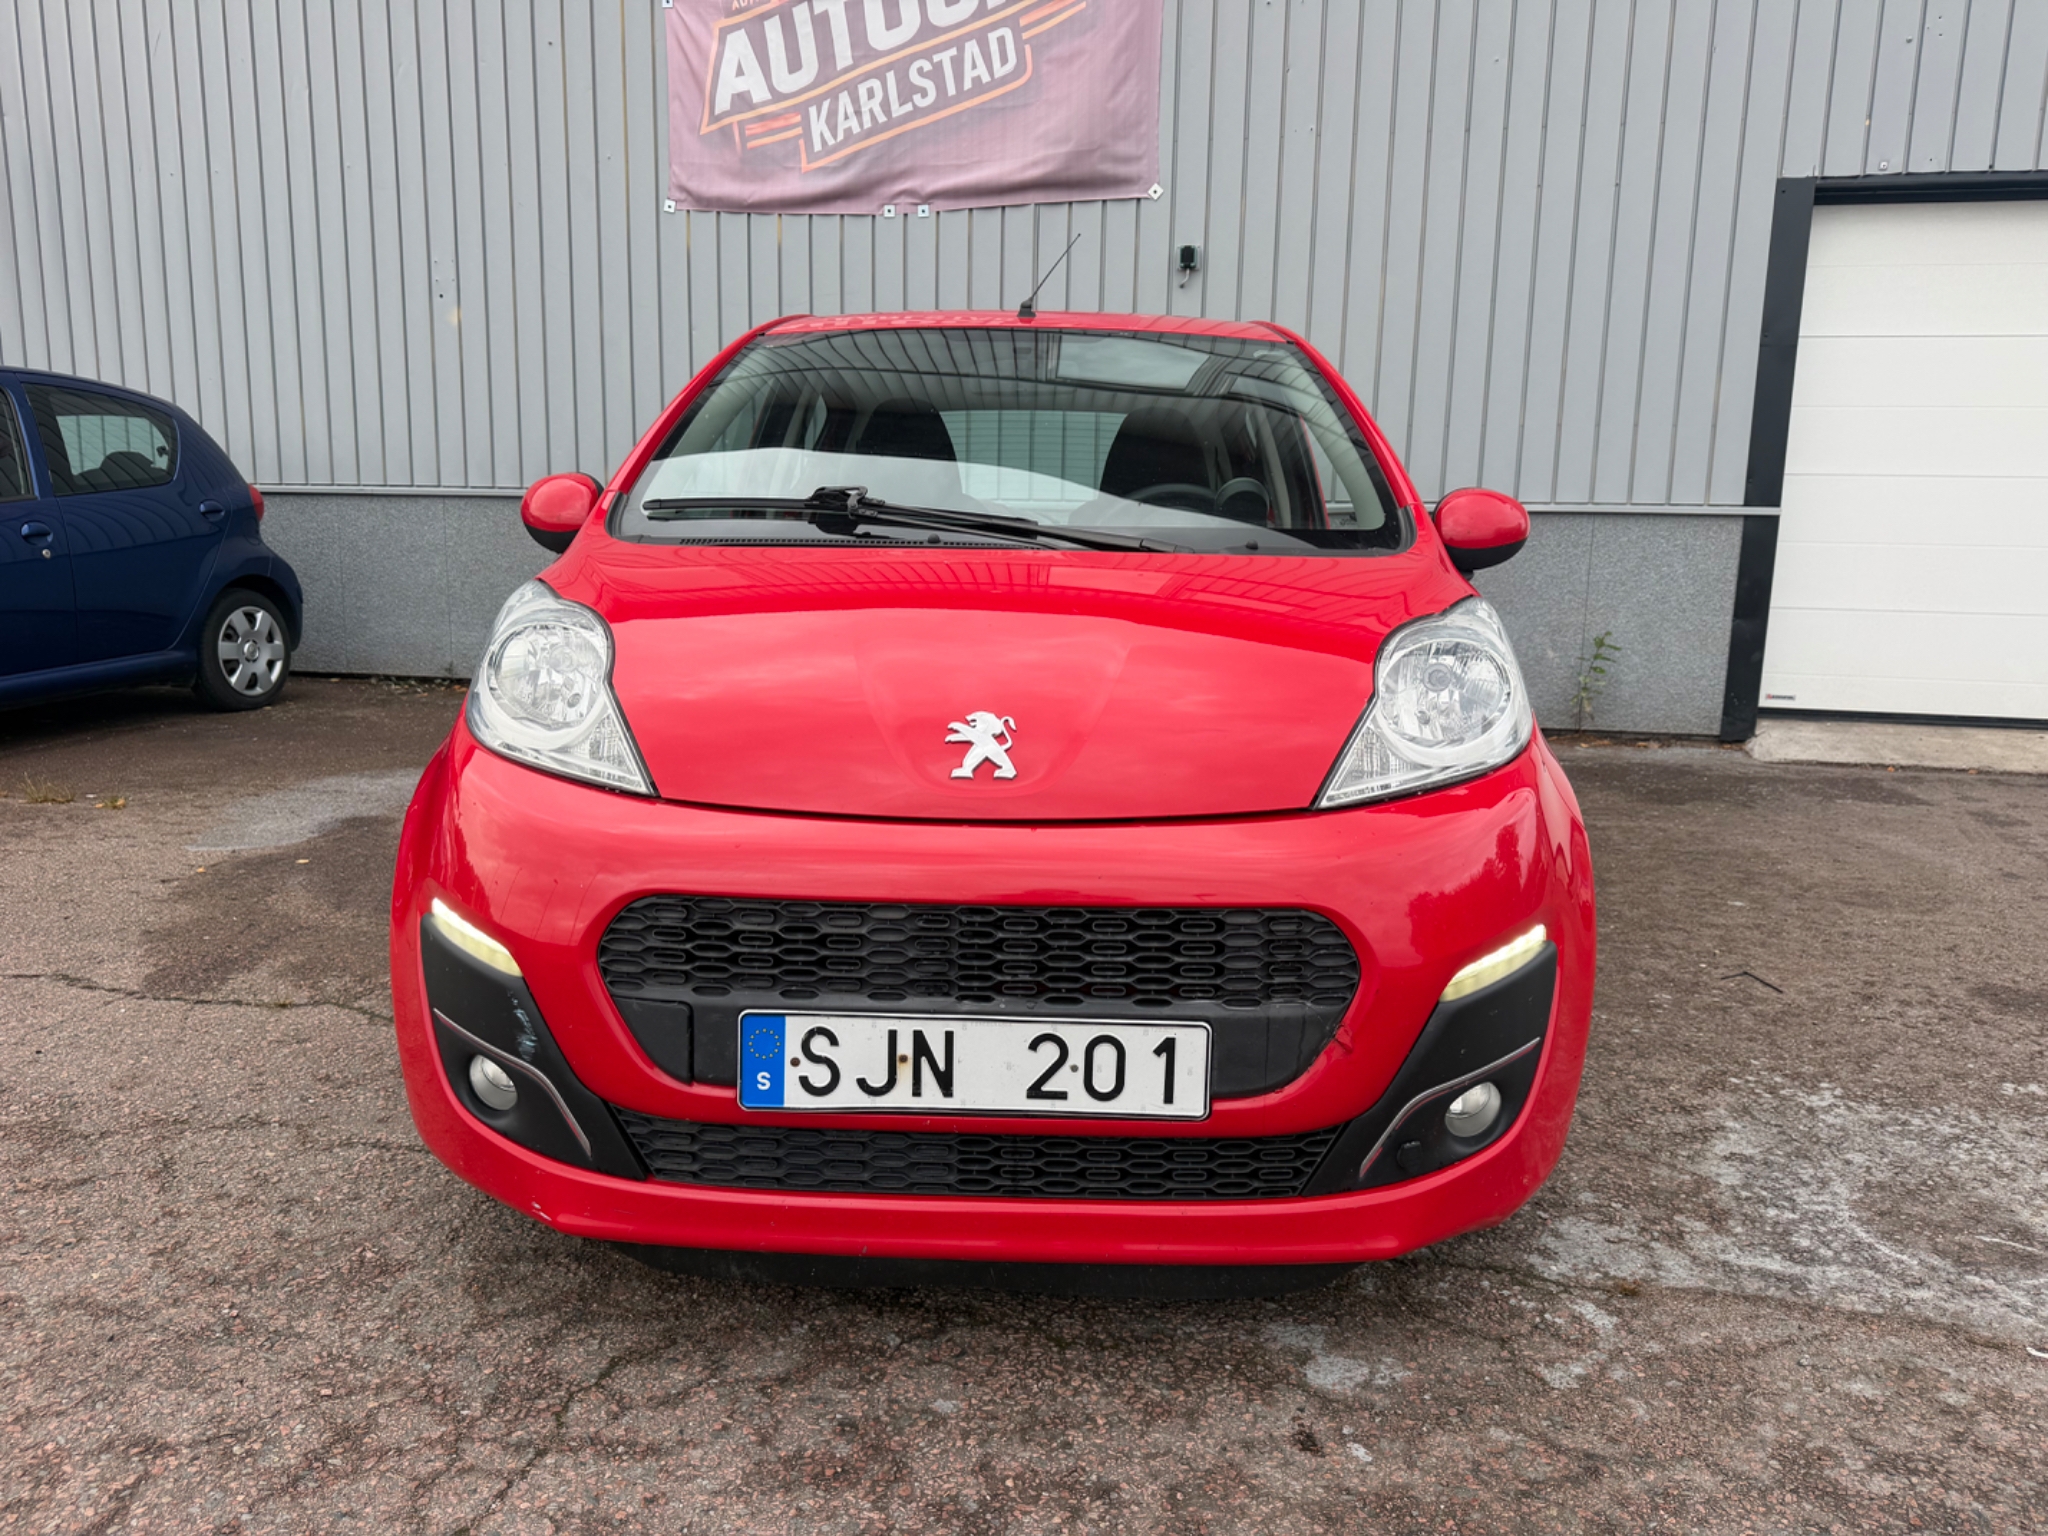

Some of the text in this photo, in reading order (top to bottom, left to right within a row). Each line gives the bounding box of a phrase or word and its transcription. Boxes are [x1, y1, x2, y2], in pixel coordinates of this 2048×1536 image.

[714, 0, 1006, 115] AUTO
[808, 27, 1018, 152] KARLSTAD
[756, 1072, 771, 1090] S
[798, 1026, 1176, 1105] SJN 201
